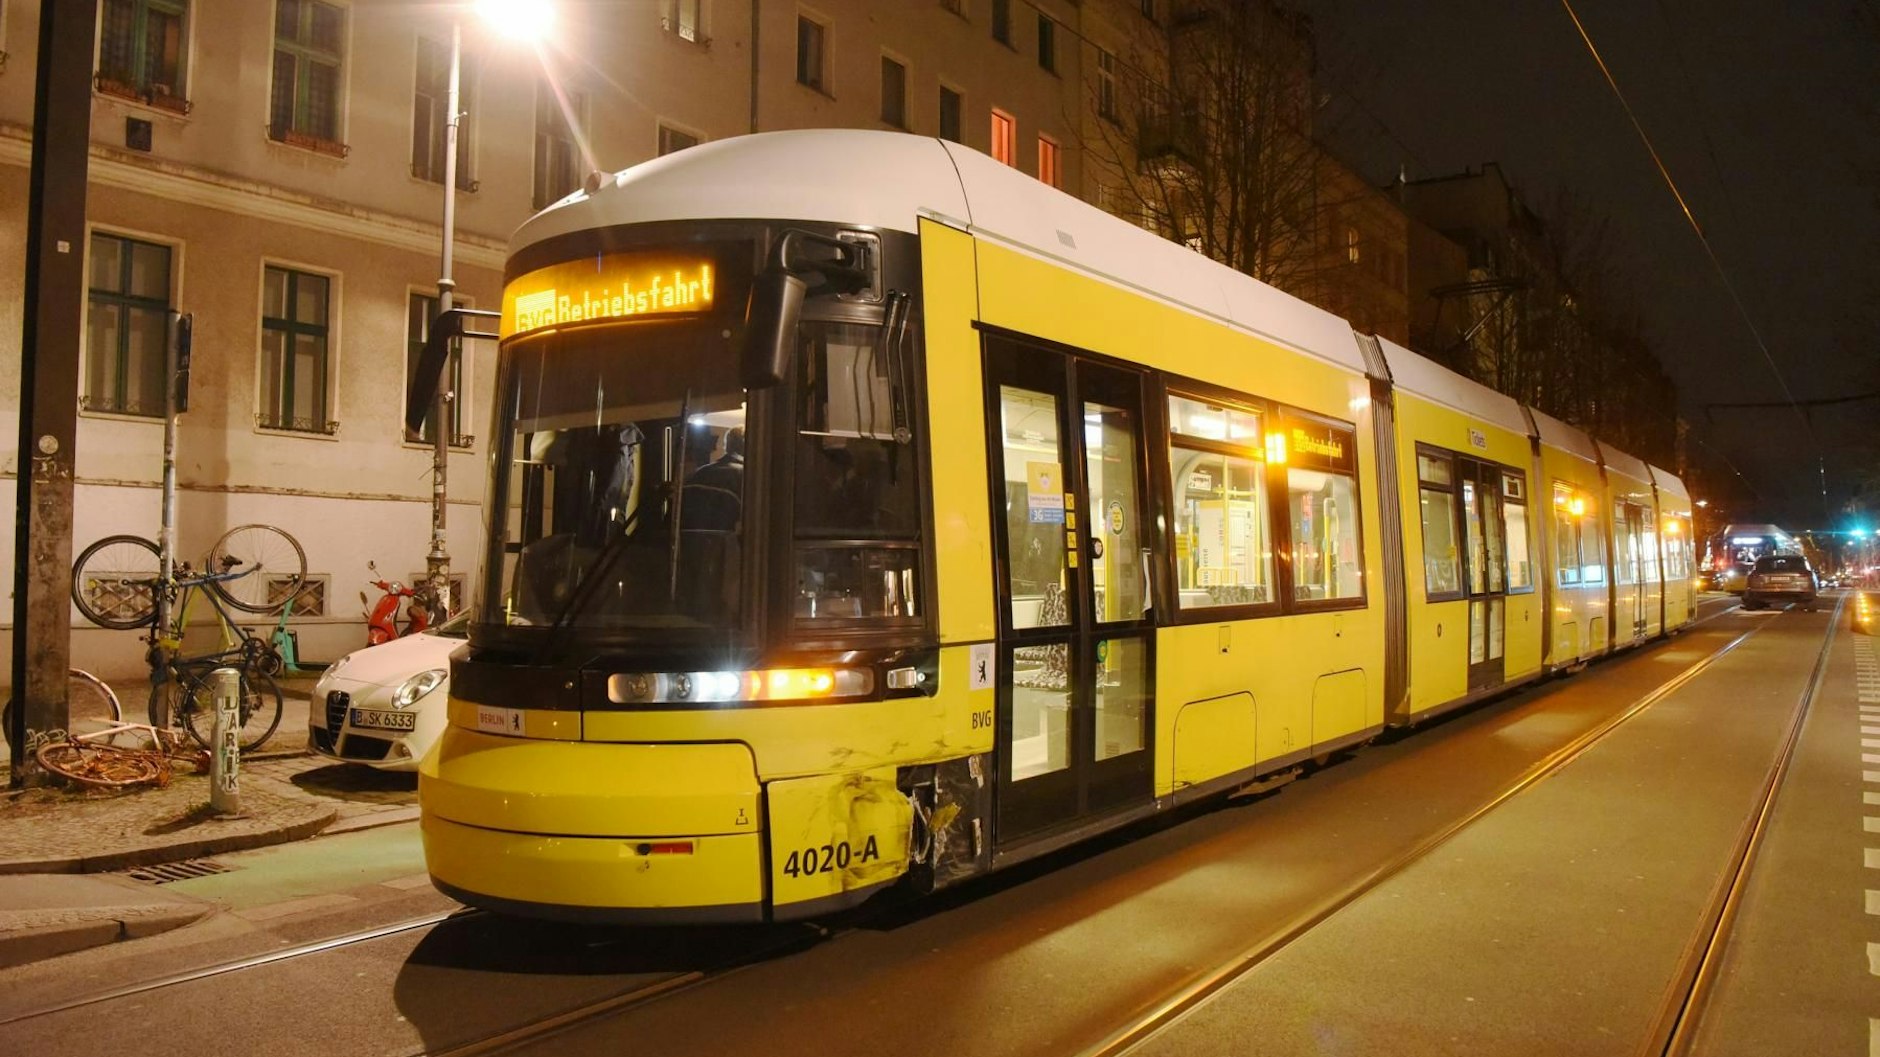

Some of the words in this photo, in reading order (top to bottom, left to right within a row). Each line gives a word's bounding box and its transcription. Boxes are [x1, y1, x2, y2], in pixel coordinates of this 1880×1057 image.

[558, 264, 710, 322] Betriebsfahrt
[356, 711, 363, 724] B
[369, 713, 382, 726] SK
[384, 714, 413, 728] 6333
[479, 712, 504, 726] BERLIN
[972, 710, 992, 730] BVG
[783, 834, 879, 878] 4020-A
